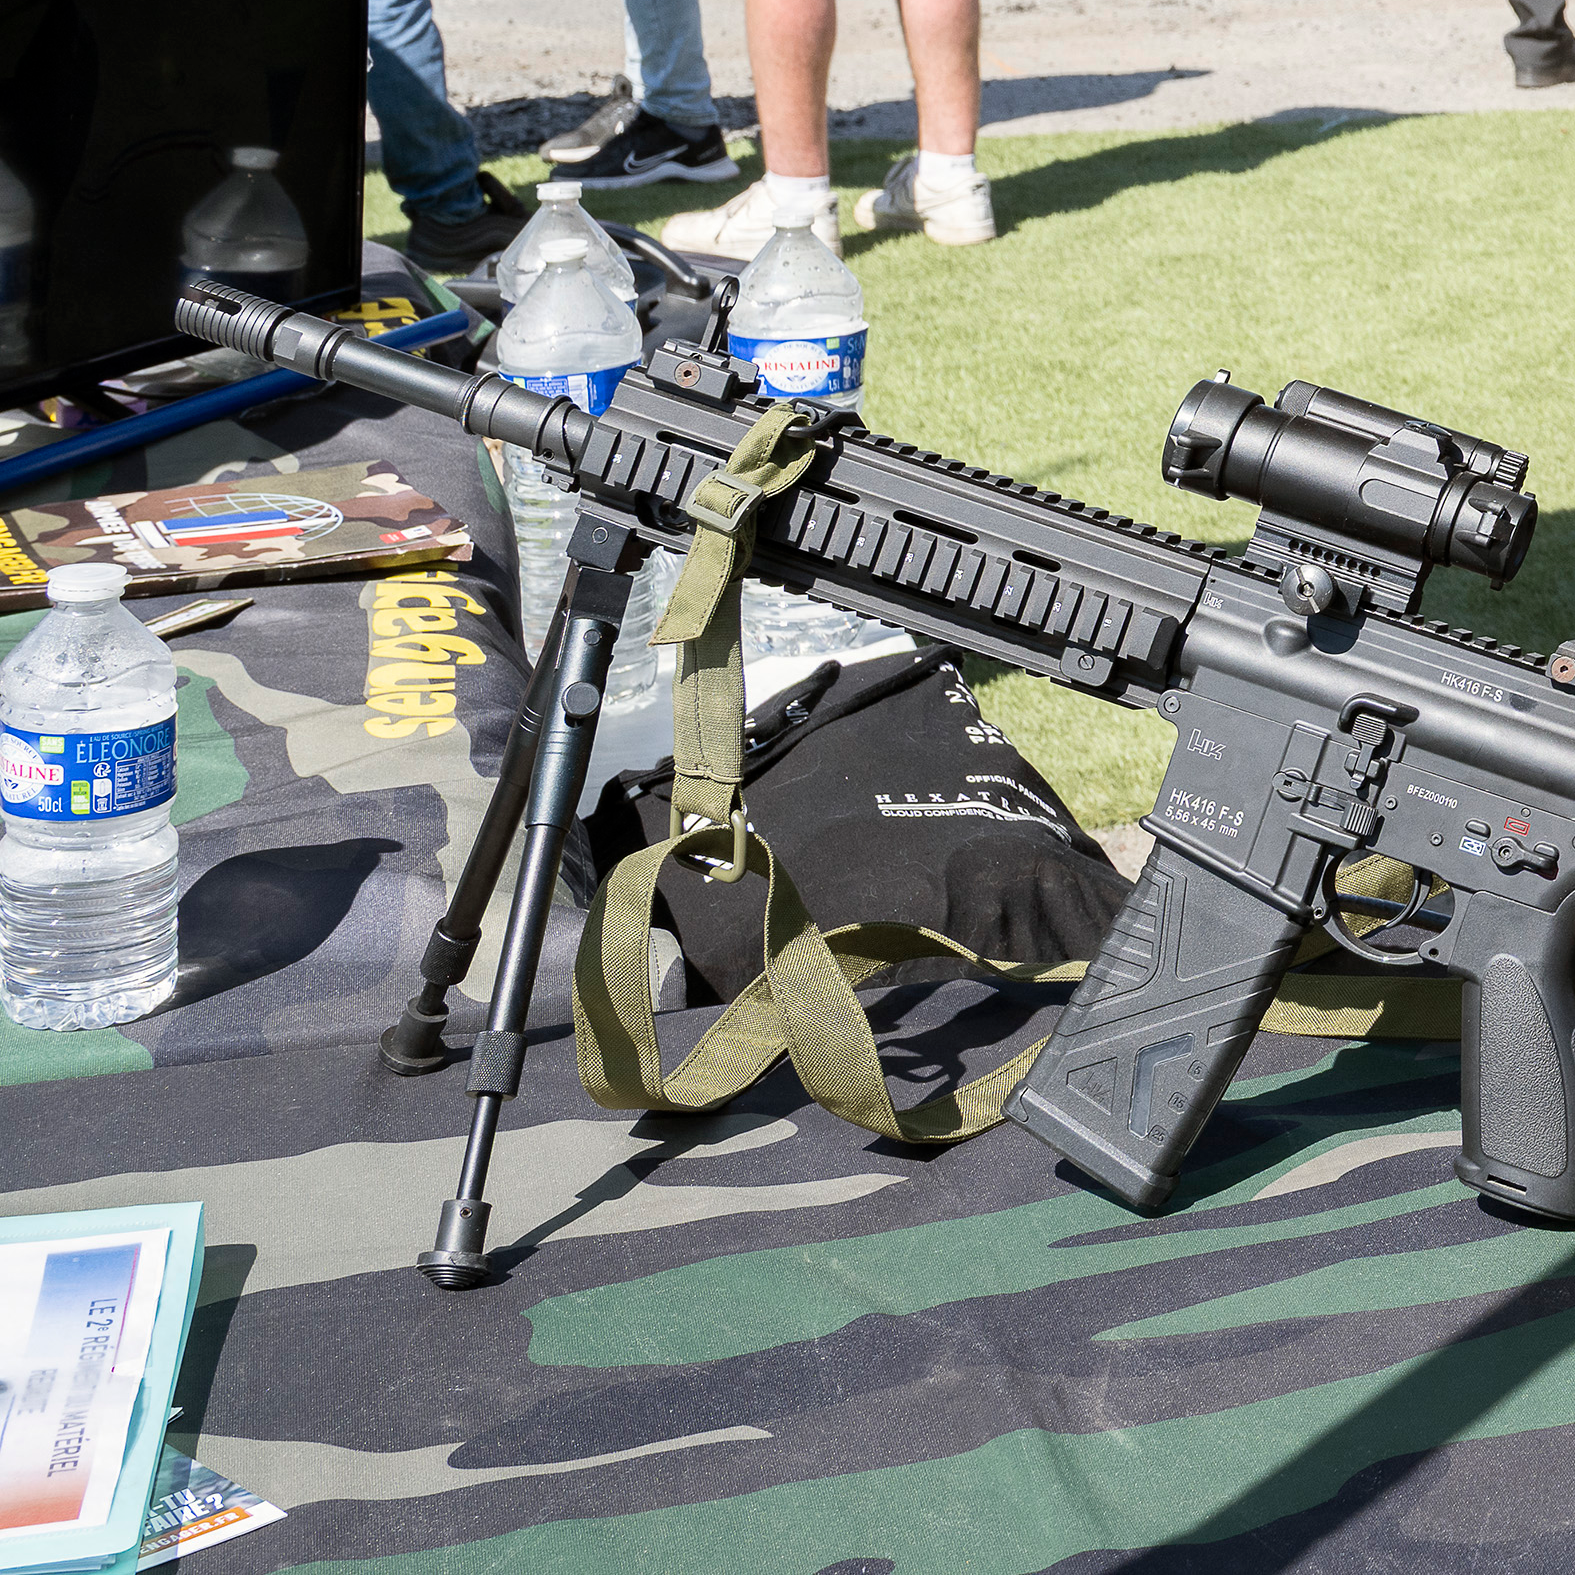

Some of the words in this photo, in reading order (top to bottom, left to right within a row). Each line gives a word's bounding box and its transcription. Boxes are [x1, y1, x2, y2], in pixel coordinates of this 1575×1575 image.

[1004, 585, 1014, 596] 22
[1053, 601, 1062, 613] 20
[1440, 671, 1480, 695] HK416
[1481, 684, 1504, 702] F-S
[38, 796, 63, 813] 50cl
[965, 775, 1017, 790] OFFICIAL
[1018, 783, 1057, 818] PARTNER
[1169, 788, 1216, 816] HK416
[1218, 805, 1245, 826] F-S
[881, 809, 922, 817] CLOUD
[924, 808, 995, 819] CONFIDENCE
[1165, 805, 1189, 822] 5,56
[1200, 818, 1216, 831] 45
[1218, 825, 1239, 838] mm
[88, 1298, 118, 1316] LE
[47, 1409, 90, 1478] MATÉRIEL
